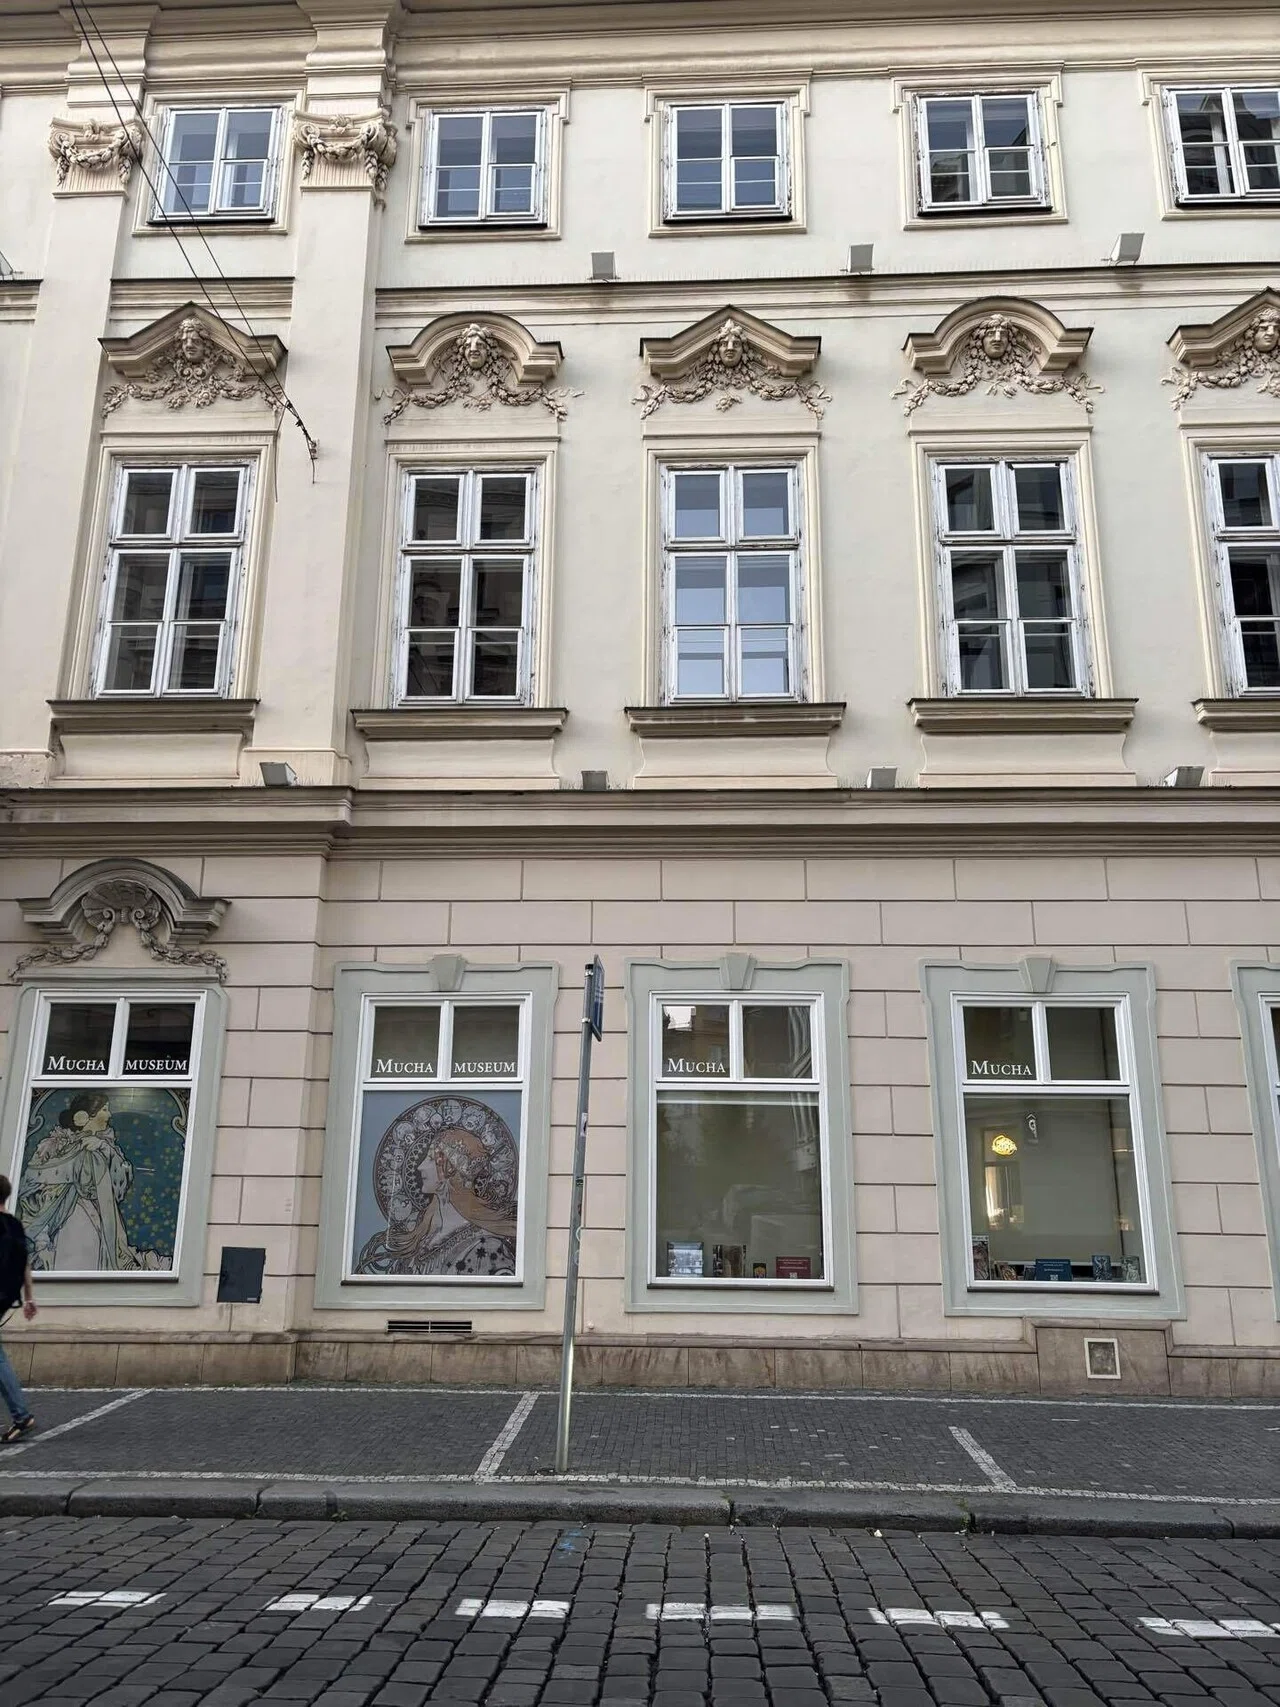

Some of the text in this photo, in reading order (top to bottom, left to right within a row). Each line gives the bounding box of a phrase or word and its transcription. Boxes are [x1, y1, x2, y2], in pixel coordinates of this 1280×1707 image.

[47, 1055, 188, 1071] MUCHA MUSEUM
[375, 1058, 516, 1074] MUCHA MUSEUM
[667, 1057, 726, 1073] MUCHA
[971, 1060, 1033, 1076] MUCHA
